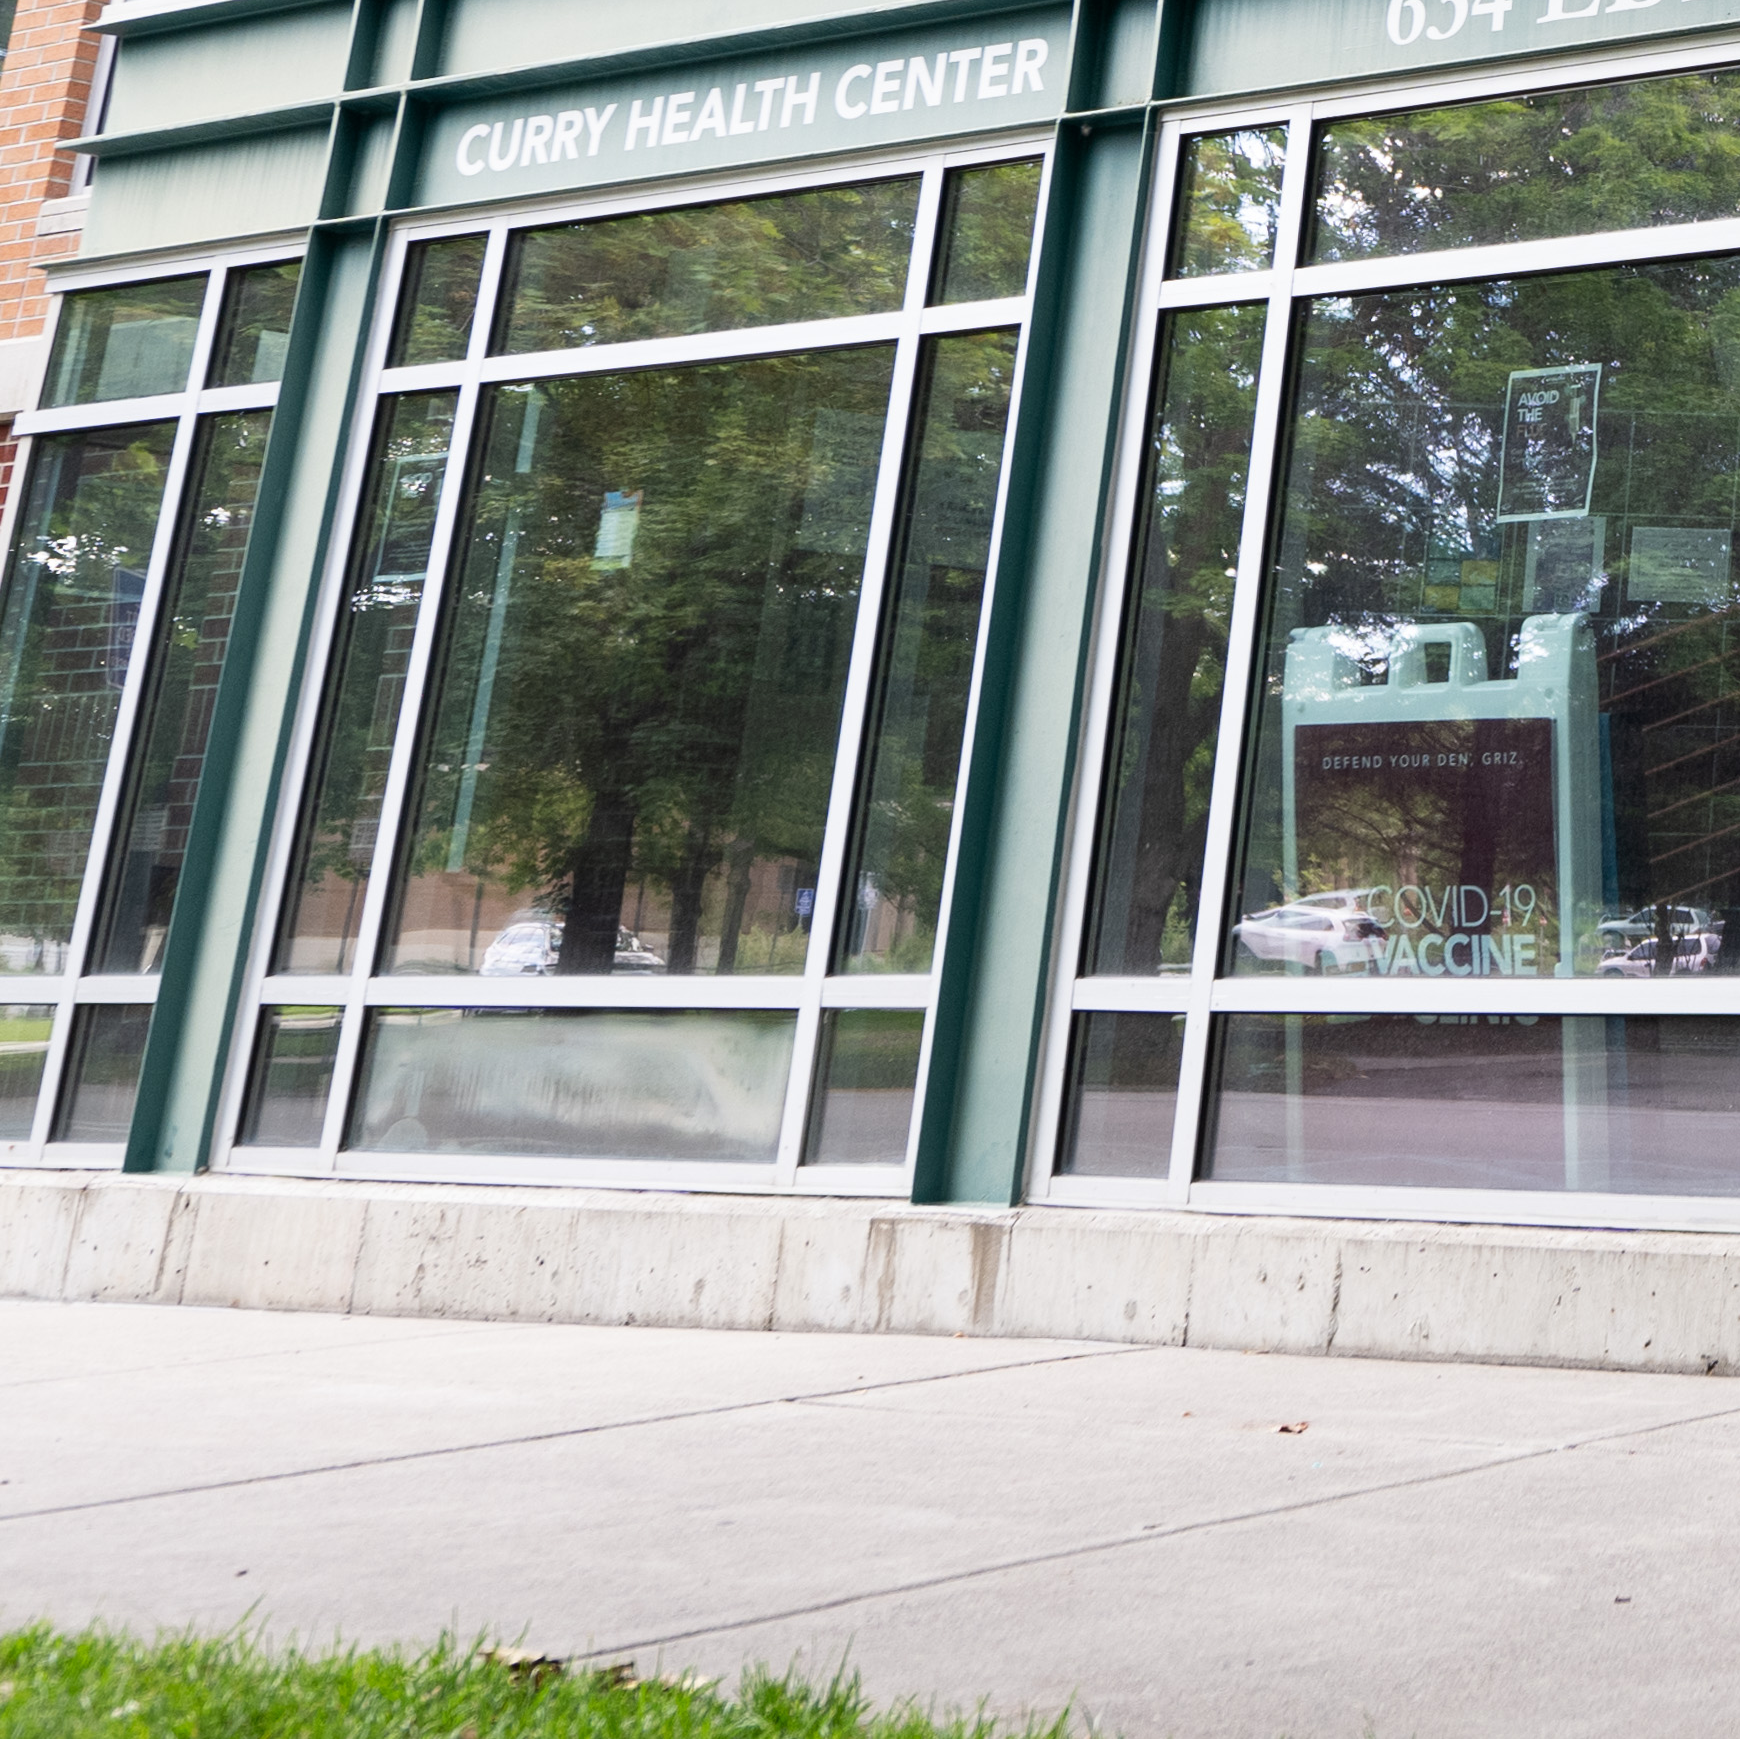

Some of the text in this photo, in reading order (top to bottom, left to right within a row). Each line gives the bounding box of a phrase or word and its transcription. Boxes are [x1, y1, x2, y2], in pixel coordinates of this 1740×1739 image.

[456, 37, 1049, 176] CURRY HEALTH CENTER
[1517, 390, 1560, 407] AVOID
[1517, 407, 1544, 422] THE
[1322, 755, 1383, 770] DEFEND
[1389, 753, 1430, 768] YOUR
[1368, 884, 1537, 929] COVID-19
[1369, 932, 1538, 977] VACCINE
